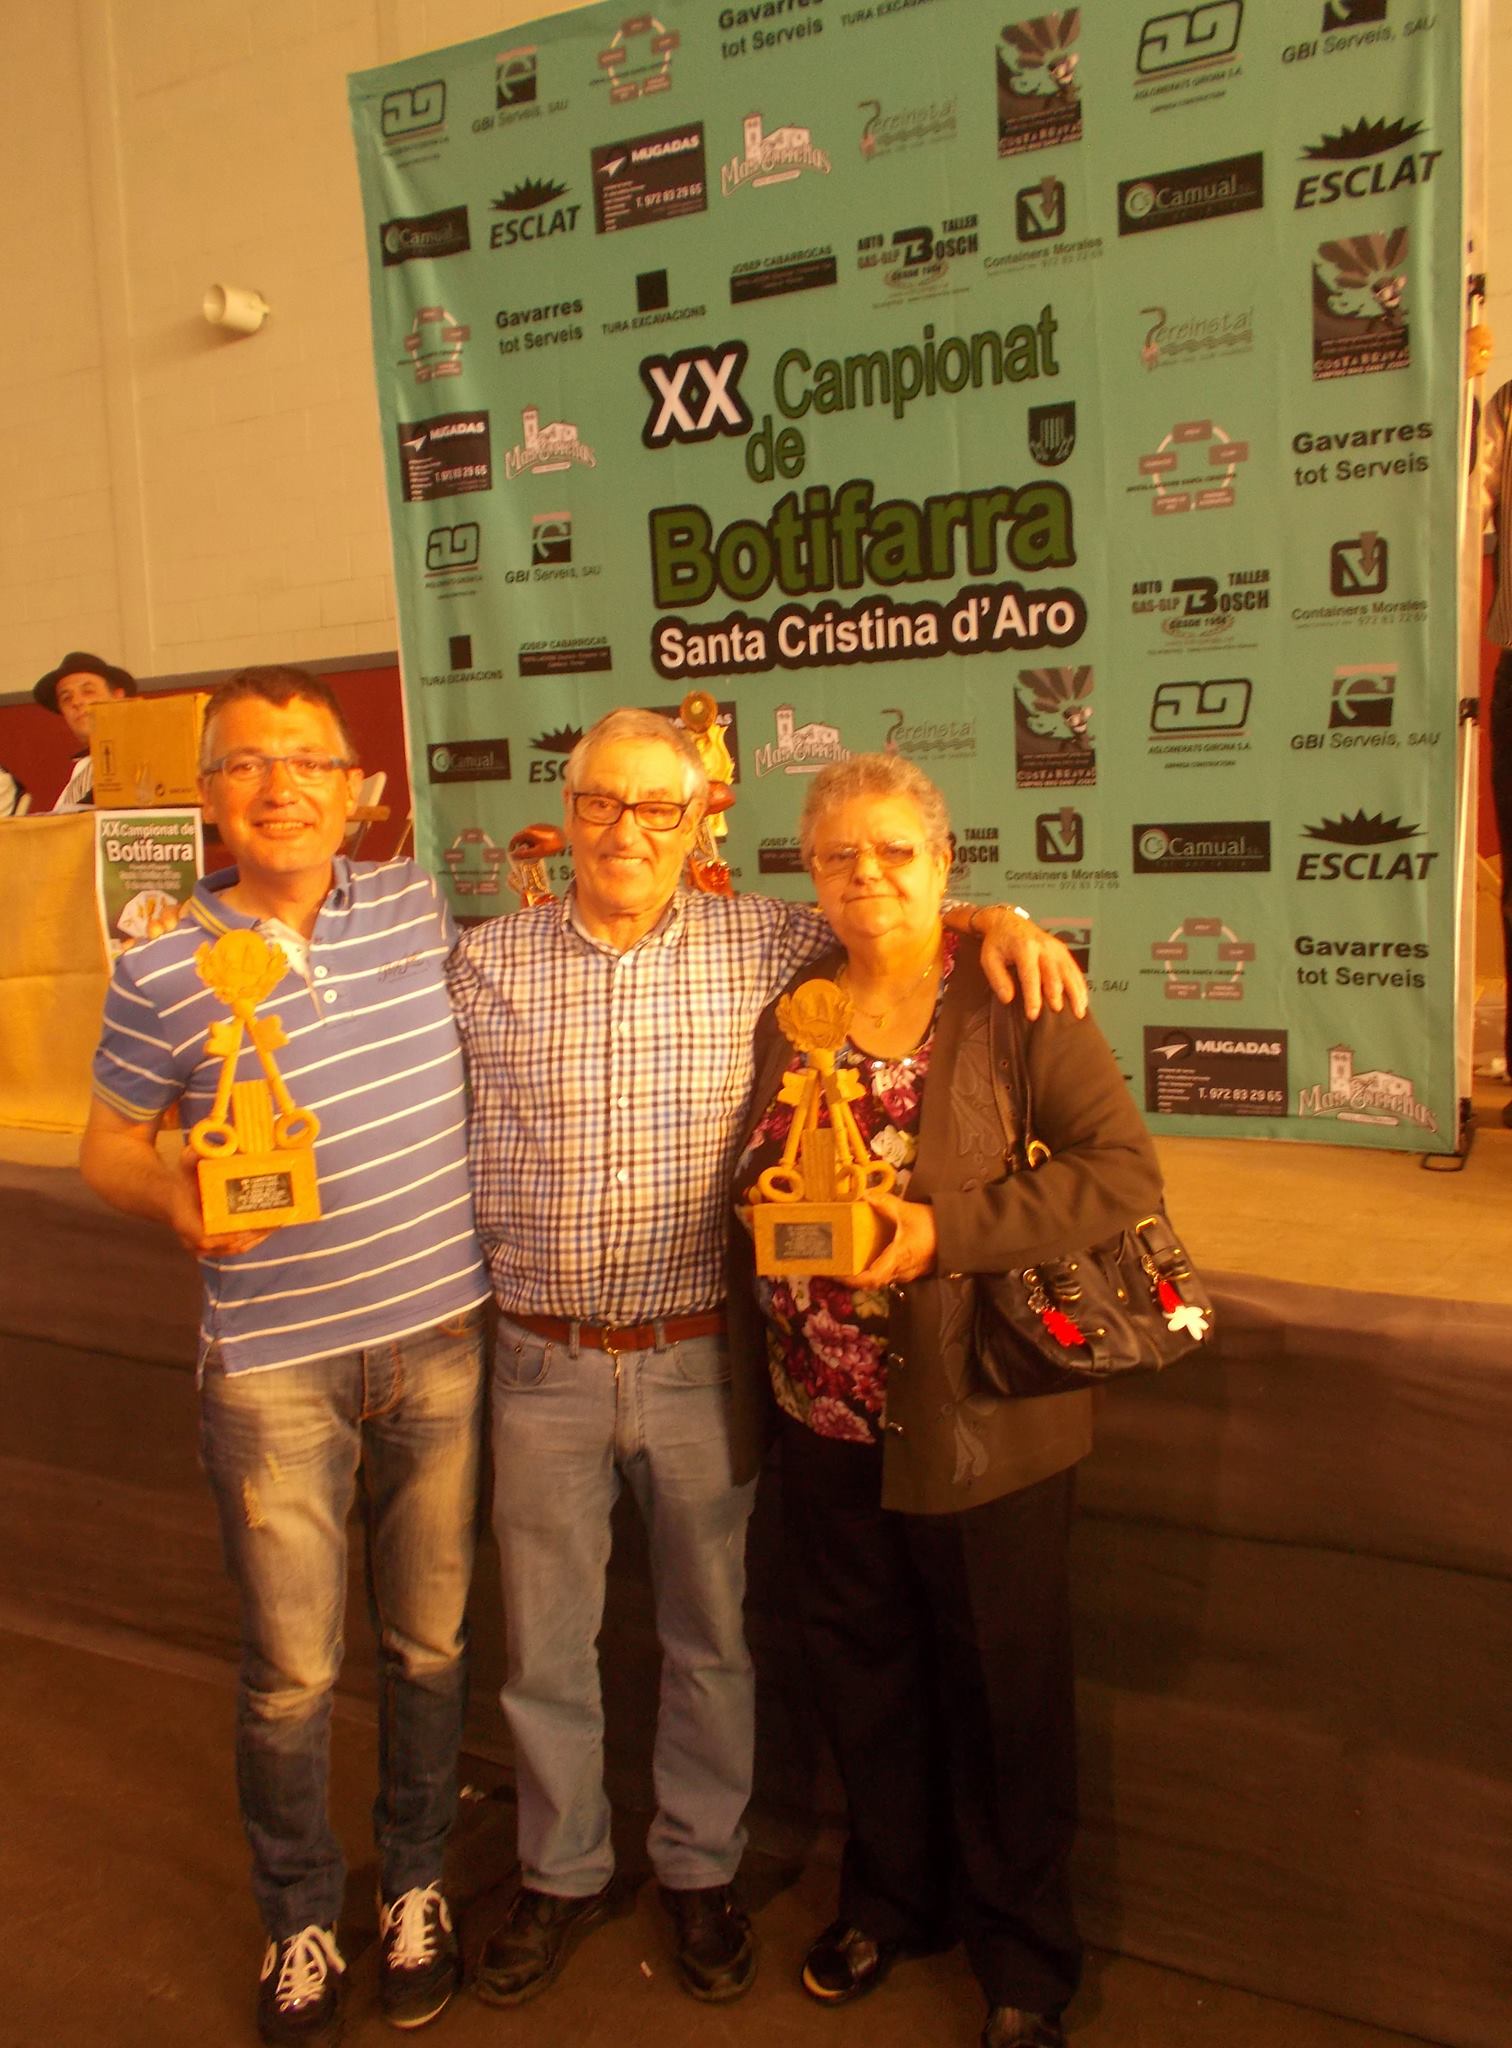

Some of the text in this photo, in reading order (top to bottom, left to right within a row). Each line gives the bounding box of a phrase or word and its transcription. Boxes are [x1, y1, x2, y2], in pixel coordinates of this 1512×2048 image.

[719, 0, 823, 30] Gavarr
[721, 17, 823, 59] tot Serveis
[1281, 41, 1319, 64] GBI
[1403, 15, 1438, 37] SAU
[631, 134, 700, 163] MUGADAS
[1156, 175, 1238, 209] Camual
[1293, 150, 1443, 210] ESCLAT
[489, 204, 582, 249] ESCLAT
[858, 213, 978, 251] AUTO TALLER
[496, 299, 583, 328] Gavarres
[602, 321, 629, 335] TURA
[500, 324, 583, 355] tot Serveis
[644, 304, 1060, 444] XX Campionat
[745, 415, 806, 483] de
[1292, 420, 1434, 455] Gavarres
[1294, 452, 1430, 487] tot Serveis
[649, 479, 1077, 609] Botifarra
[504, 570, 531, 584] GBI
[1132, 569, 1270, 596] AUTO TALLER
[1291, 600, 1428, 621] Containers Morales
[659, 595, 1077, 669] Santa Cristina d'Aro
[1290, 734, 1324, 750] GBI
[1406, 731, 1441, 746] SAU
[102, 821, 195, 838] XX Campionat de
[964, 828, 999, 841] TALLER
[106, 838, 194, 862] Botifarra
[1168, 837, 1246, 857] Camual
[1005, 869, 1119, 880] Containers Morales
[1296, 852, 1440, 881] ESCLAT
[1294, 935, 1430, 960] Gavarres
[1102, 980, 1130, 992] SAU
[1296, 966, 1426, 989] tot Serveis
[1195, 1040, 1281, 1055] MUGADAS
